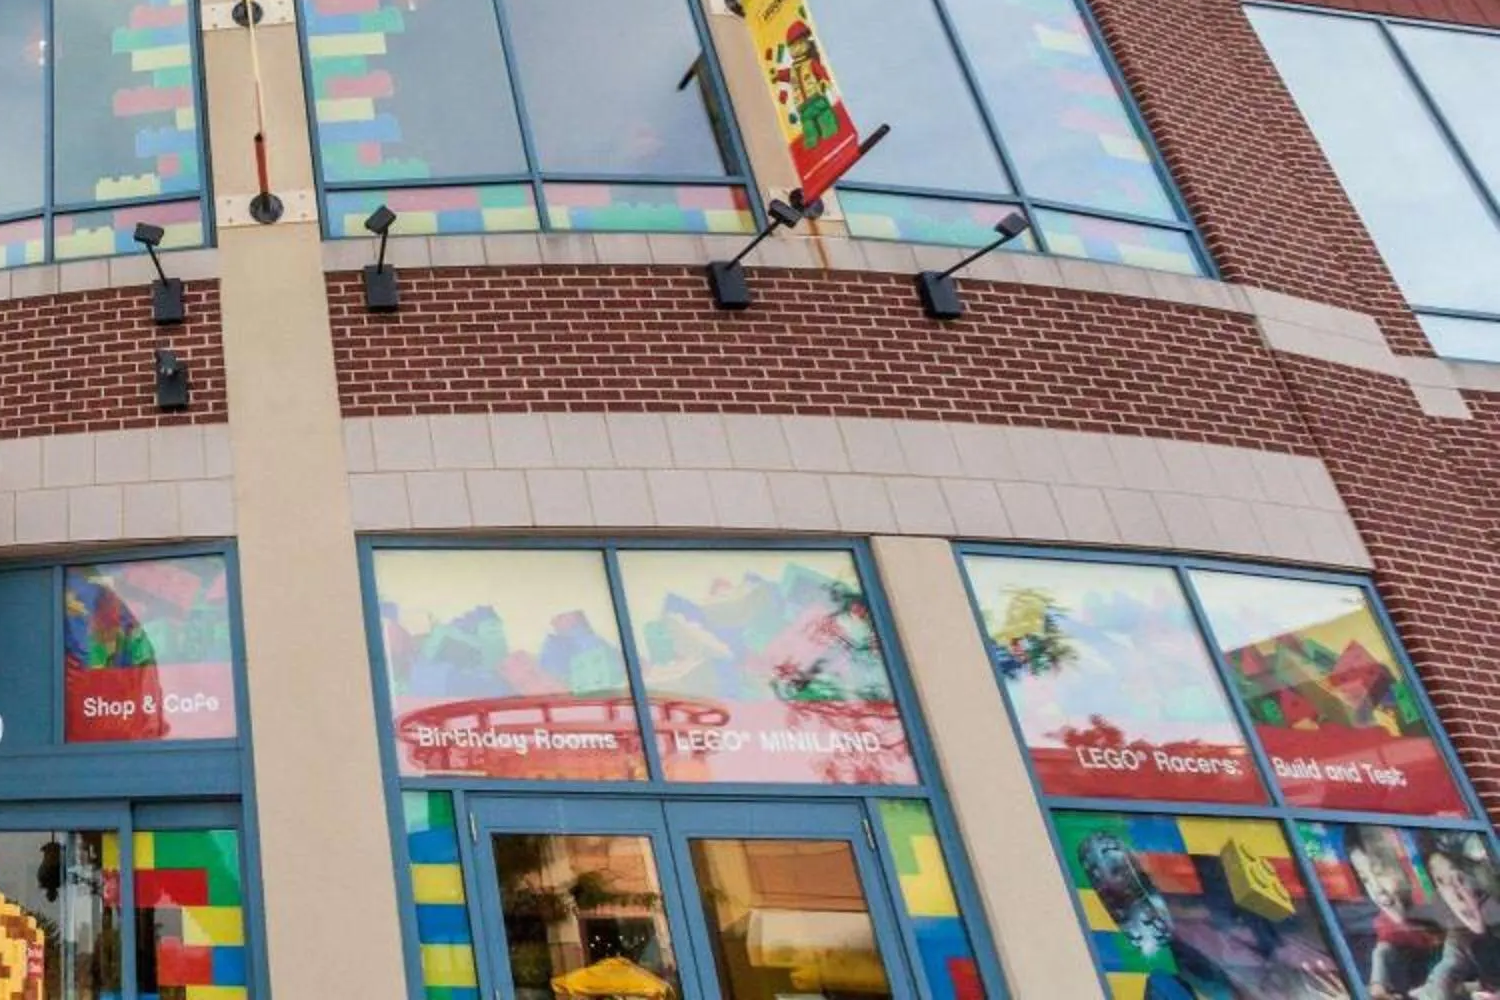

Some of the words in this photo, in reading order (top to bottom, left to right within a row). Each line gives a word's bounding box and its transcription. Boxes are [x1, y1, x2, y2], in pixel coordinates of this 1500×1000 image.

[83, 695, 136, 720] Shop
[142, 694, 157, 714] &
[419, 726, 528, 756] Birthday
[533, 728, 619, 750] Rooms
[758, 730, 882, 753] MINILAND
[1271, 756, 1323, 781] Build
[1324, 761, 1364, 784] and
